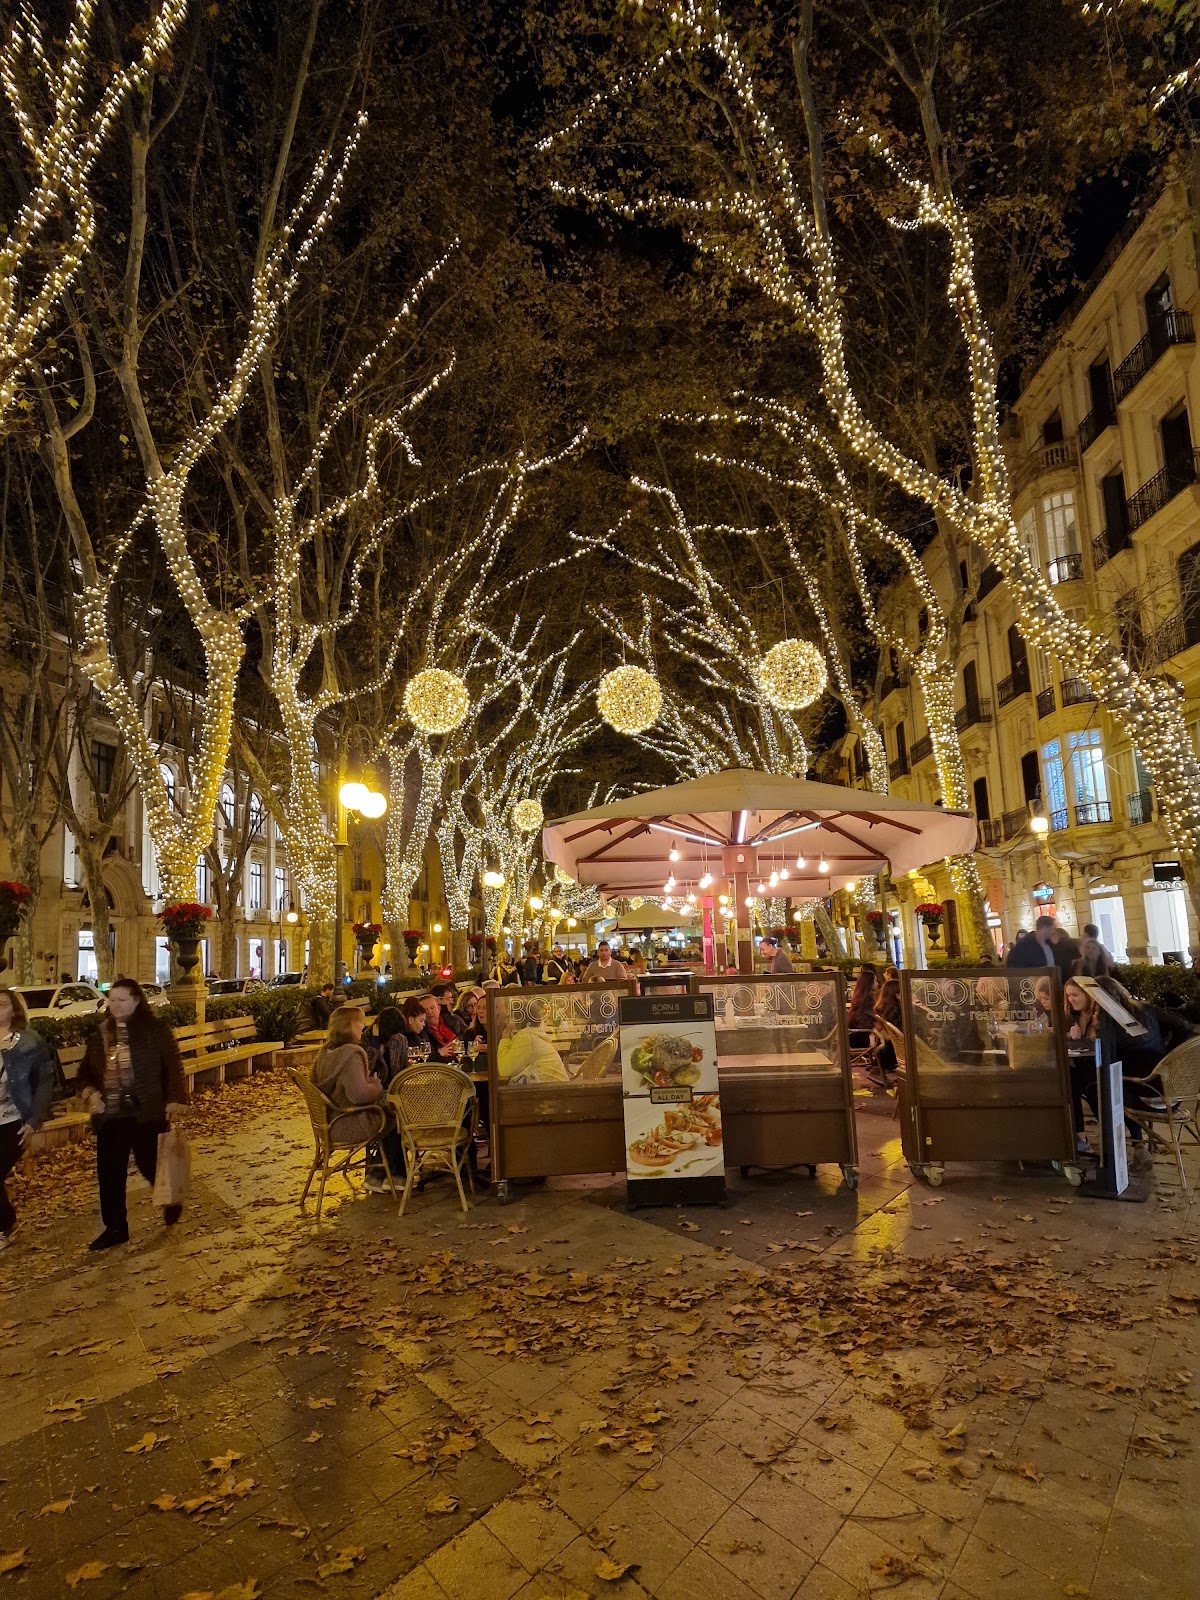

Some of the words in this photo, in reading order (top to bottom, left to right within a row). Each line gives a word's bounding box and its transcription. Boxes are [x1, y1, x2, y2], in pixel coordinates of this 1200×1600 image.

[713, 985, 797, 1013] BORN
[806, 984, 822, 1009] 8
[924, 979, 1010, 1006] BORN
[1020, 979, 1036, 1004] 8
[510, 994, 592, 1024] BORN
[600, 992, 616, 1018] 8
[969, 1007, 1039, 1021] restaurant
[558, 1020, 617, 1034] taurant
